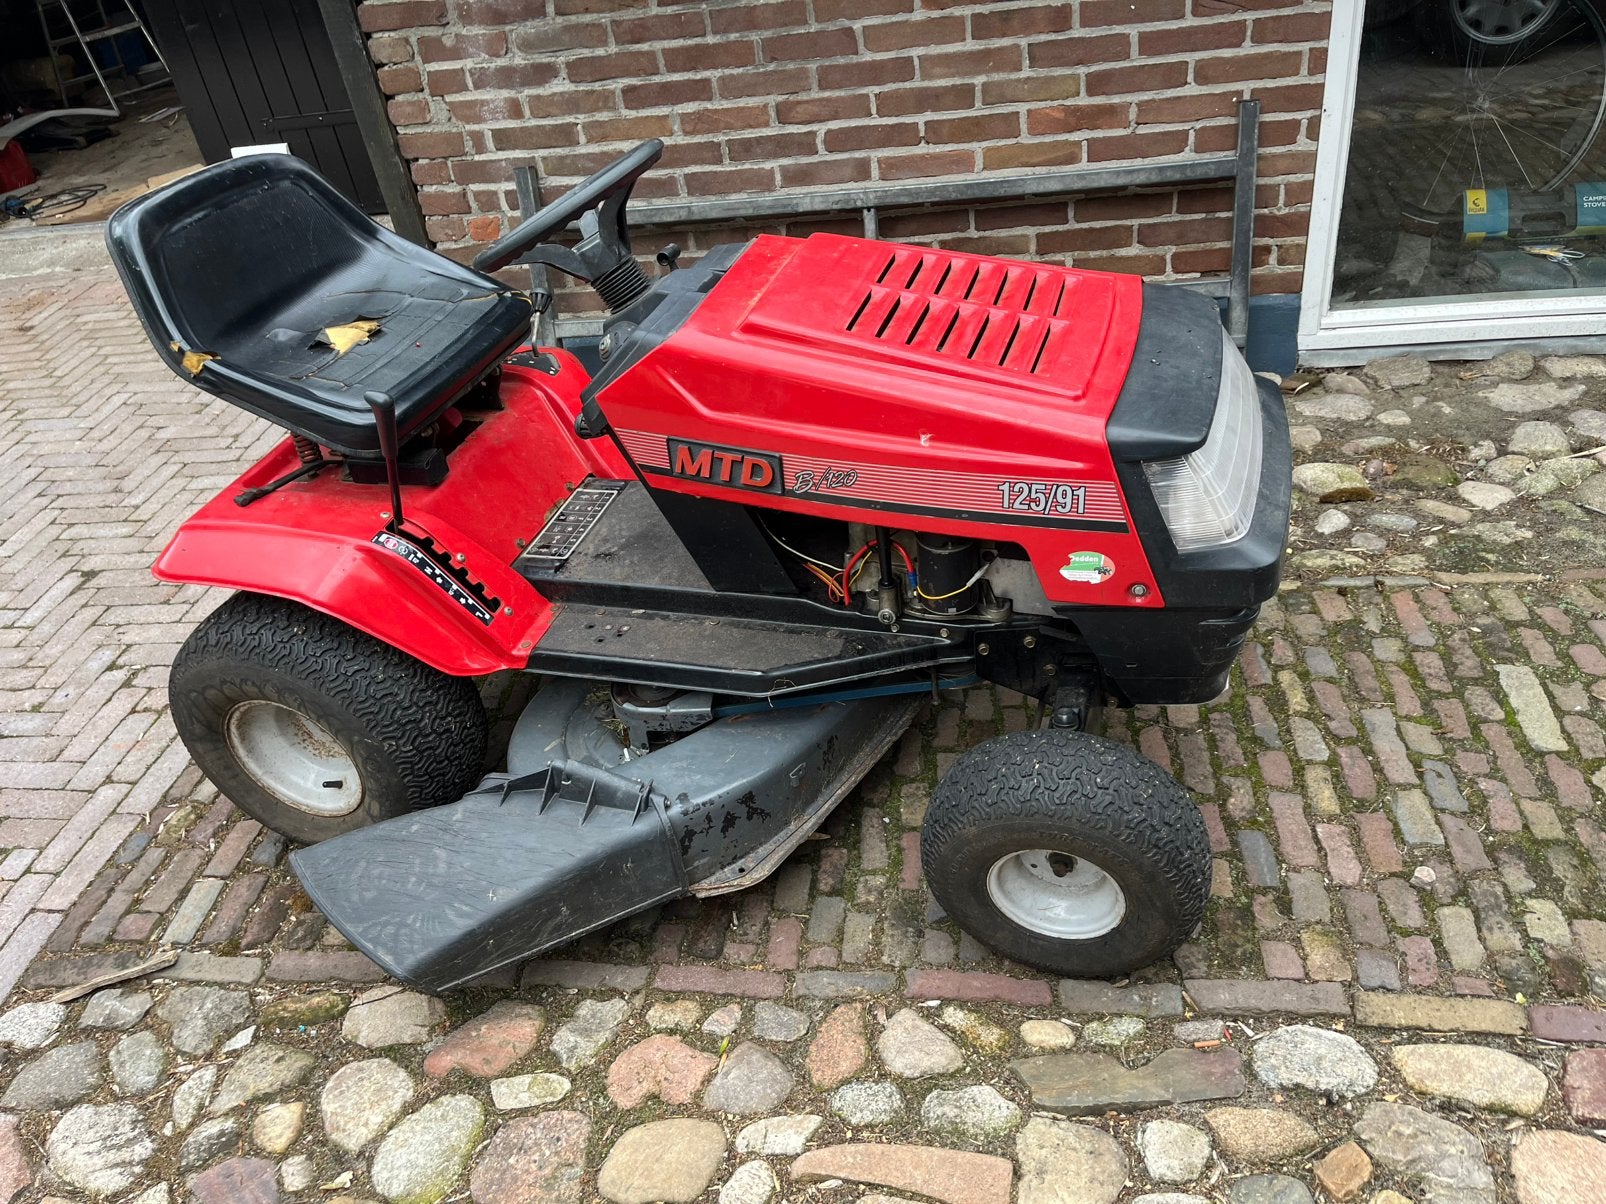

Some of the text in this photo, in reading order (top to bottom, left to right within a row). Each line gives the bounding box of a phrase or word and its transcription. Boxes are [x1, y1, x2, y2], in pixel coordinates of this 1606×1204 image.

[675, 445, 774, 488] MTD
[793, 466, 858, 494] B/120
[998, 481, 1086, 515] 125/91
